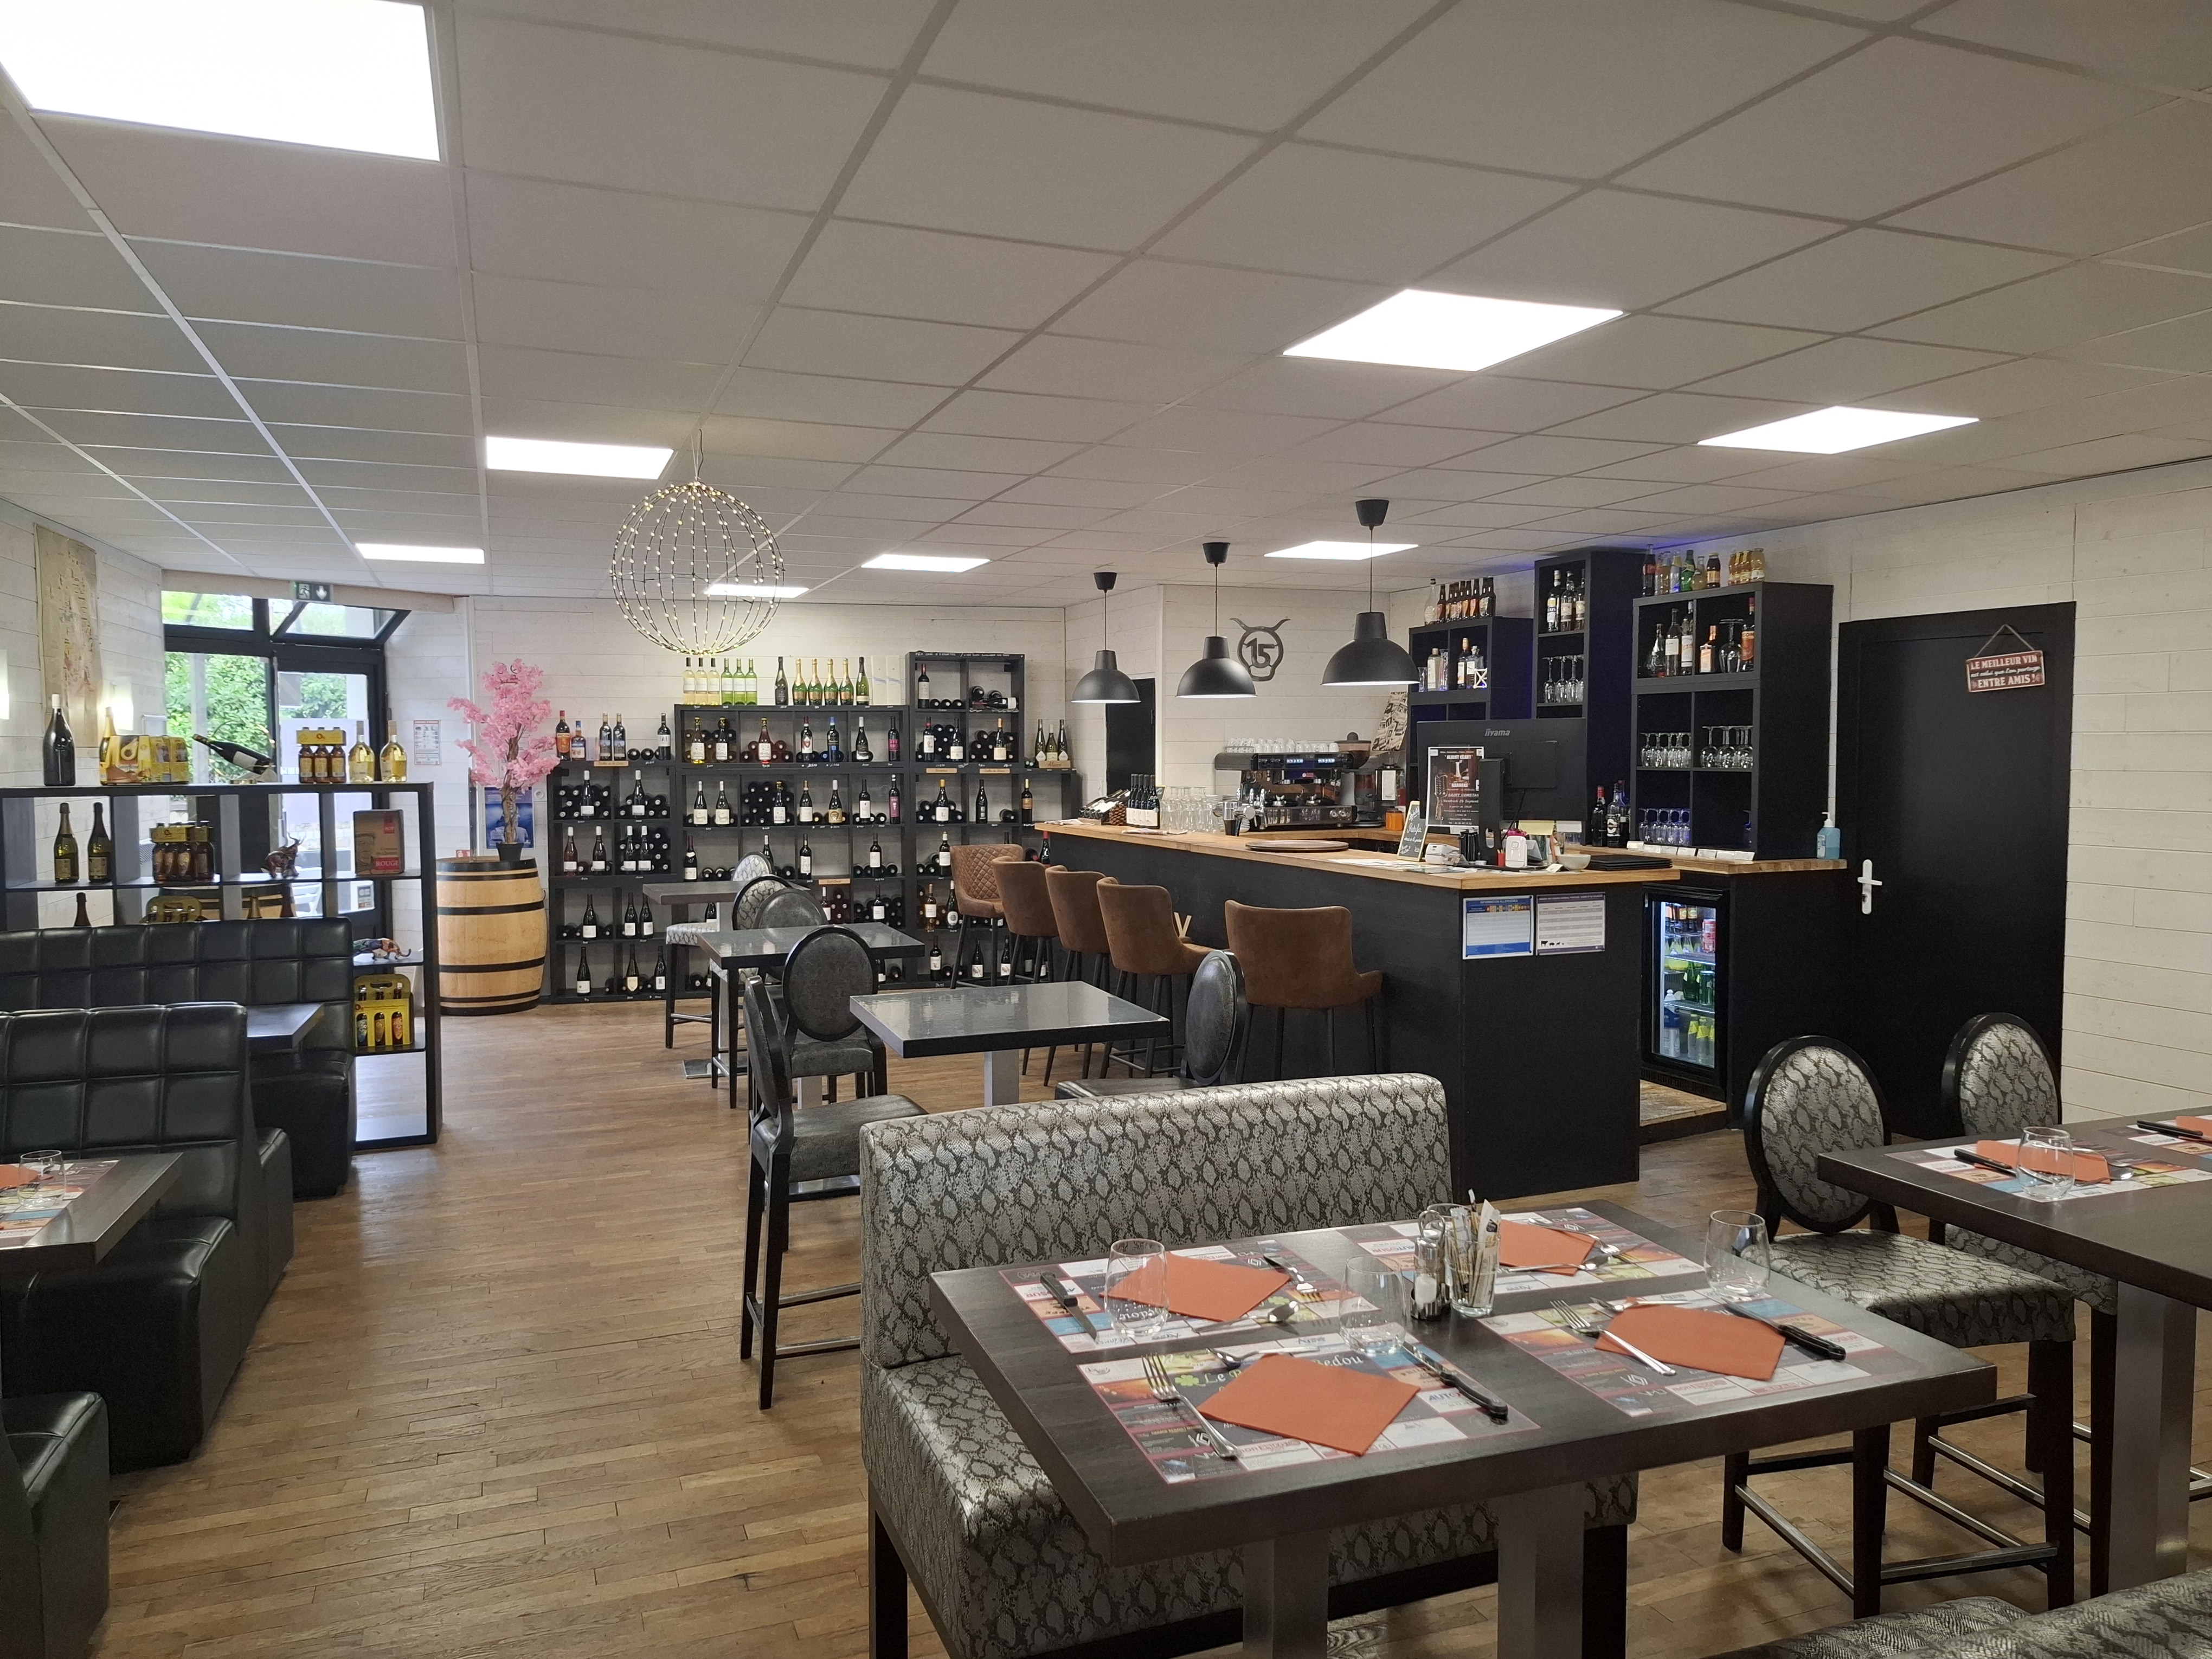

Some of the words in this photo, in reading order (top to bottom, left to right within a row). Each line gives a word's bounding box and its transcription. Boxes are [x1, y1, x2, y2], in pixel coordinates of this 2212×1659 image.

[1245, 637, 1275, 668] 15
[1970, 661, 1980, 670] LE
[1981, 657, 2022, 668] MEILLEUR
[2022, 654, 2037, 664] VIN
[1978, 677, 2006, 688] ENTRE
[2008, 674, 2031, 685] AMIS
[1484, 728, 1510, 737] iiyama
